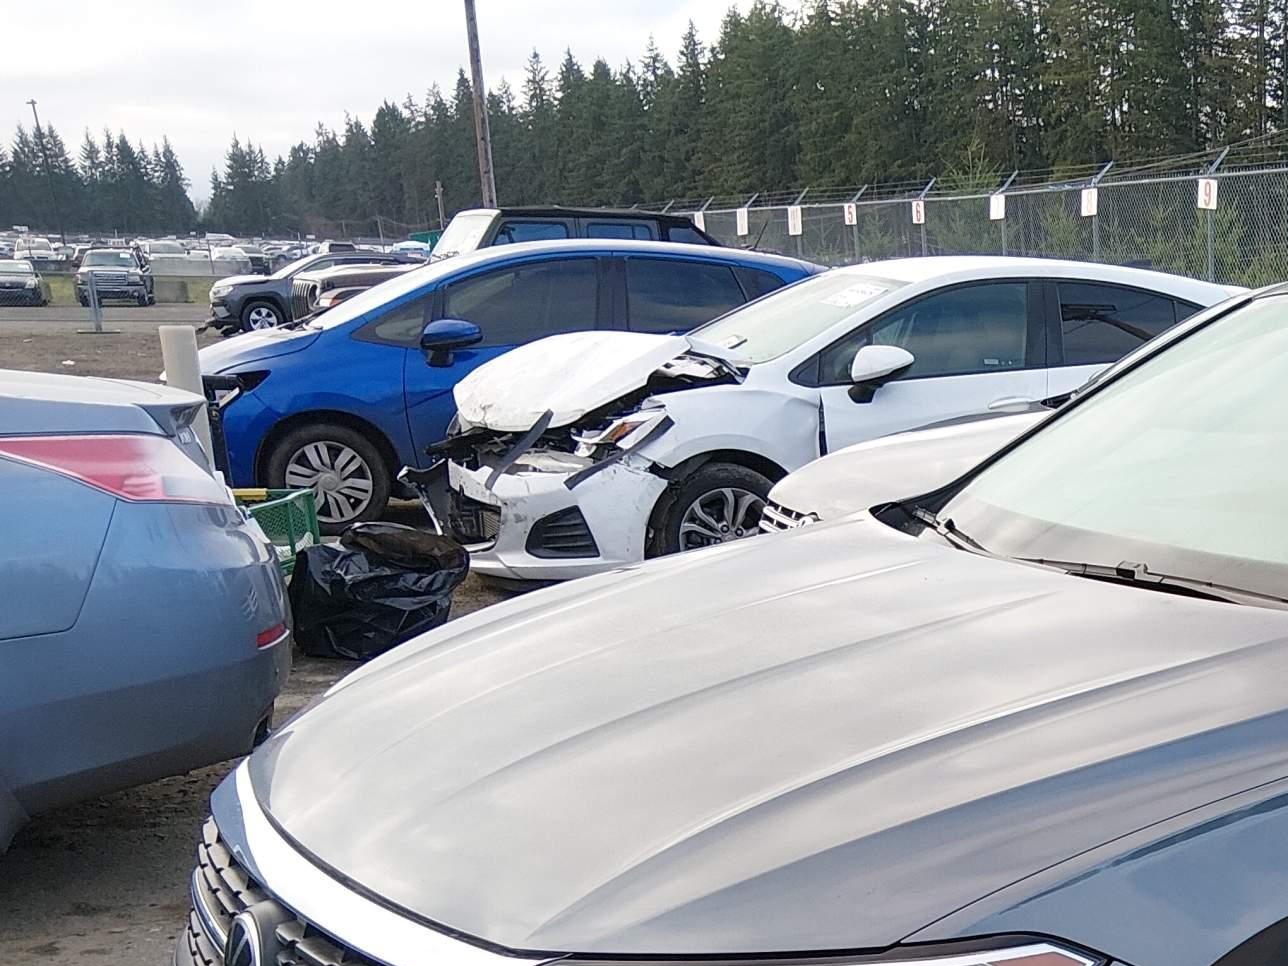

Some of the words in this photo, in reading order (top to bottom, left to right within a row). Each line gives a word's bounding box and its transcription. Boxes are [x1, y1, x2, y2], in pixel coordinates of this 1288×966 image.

[1204, 181, 1212, 207] 9
[847, 204, 854, 224] 5
[915, 203, 922, 222] 6
